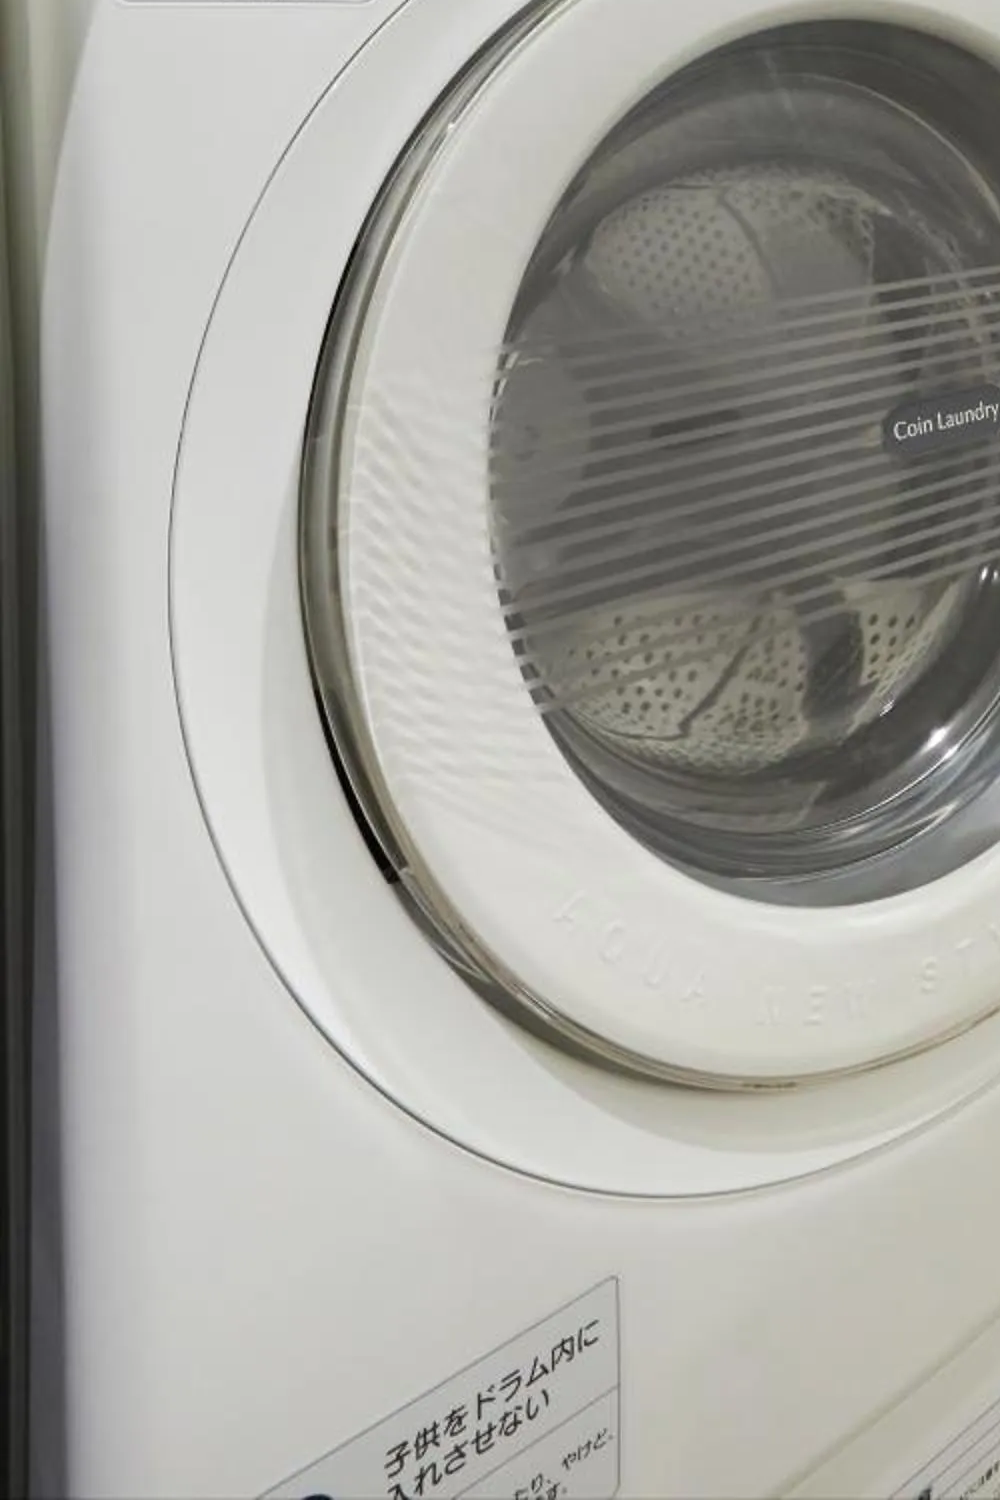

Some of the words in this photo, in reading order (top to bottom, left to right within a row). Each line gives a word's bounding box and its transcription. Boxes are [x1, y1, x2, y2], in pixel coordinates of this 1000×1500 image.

[893, 416, 934, 441] Coin
[936, 400, 999, 431] Laundry
[383, 1319, 601, 1480] 子供をドラム内に
[387, 1389, 551, 1500] 入れさせない
